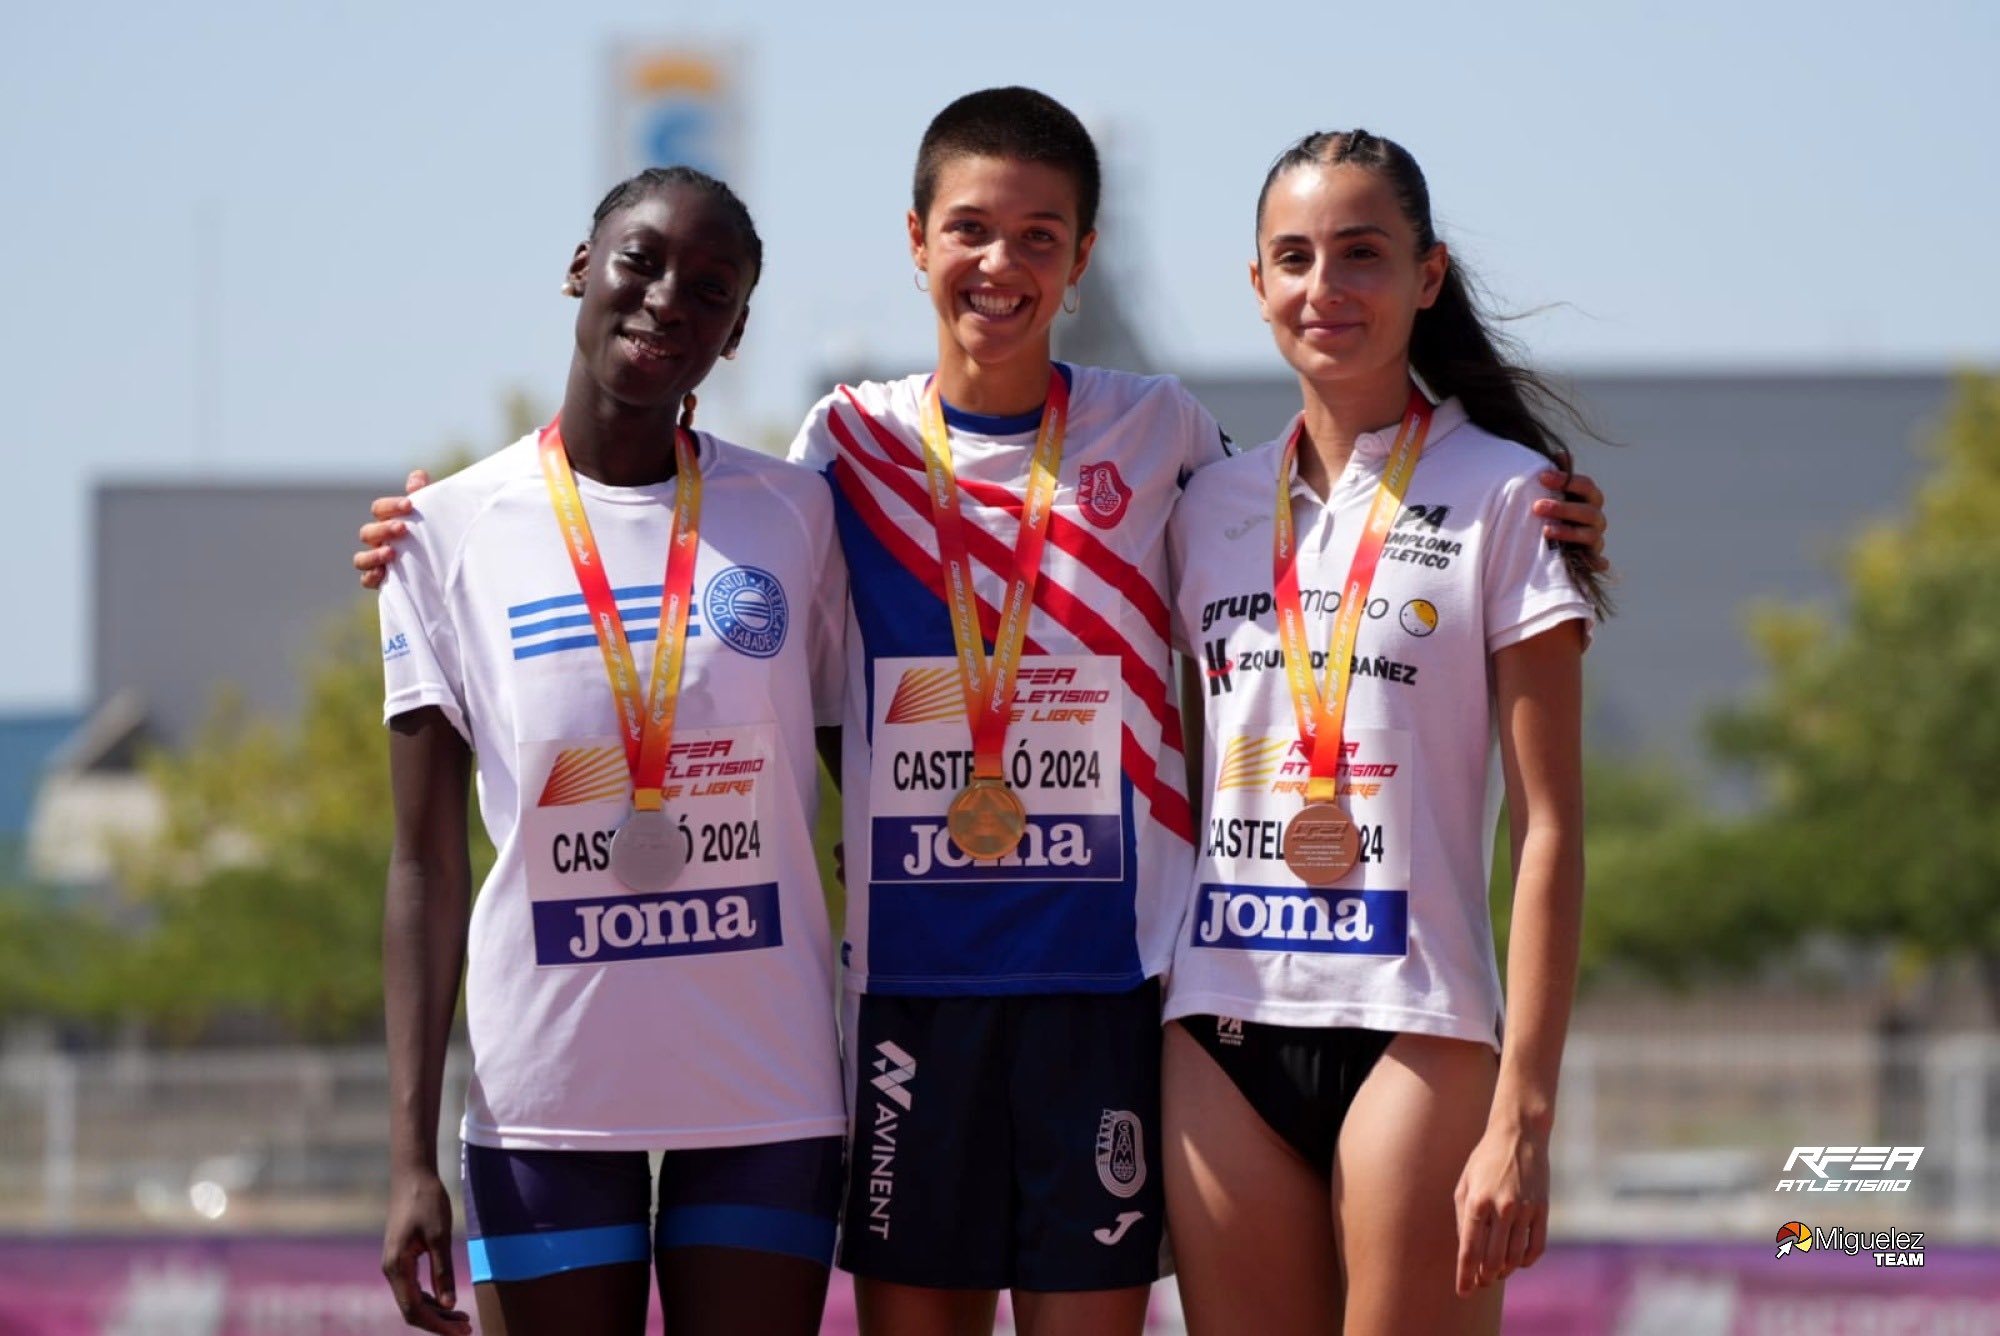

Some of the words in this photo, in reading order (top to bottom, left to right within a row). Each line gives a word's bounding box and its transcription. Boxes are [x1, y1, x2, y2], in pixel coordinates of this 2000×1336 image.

[1384, 532, 1463, 556] MPLONA
[1382, 546, 1451, 570] TLETICO
[1014, 668, 1077, 685] FEA
[1012, 690, 1110, 703] LETISMO
[1030, 709, 1097, 725] LIBRE
[667, 740, 734, 764] FEA
[665, 758, 765, 779] LETISMO
[893, 739, 1032, 791] CASTEÓ
[1039, 750, 1100, 789] 2024
[1280, 762, 1399, 778] ATTISMO
[689, 780, 754, 796] LIBRE
[701, 820, 761, 863] 2024
[1359, 824, 1385, 864] 24
[569, 894, 757, 958] Joma
[1200, 890, 1375, 943] Joma
[868, 1103, 898, 1241] AVINENT
